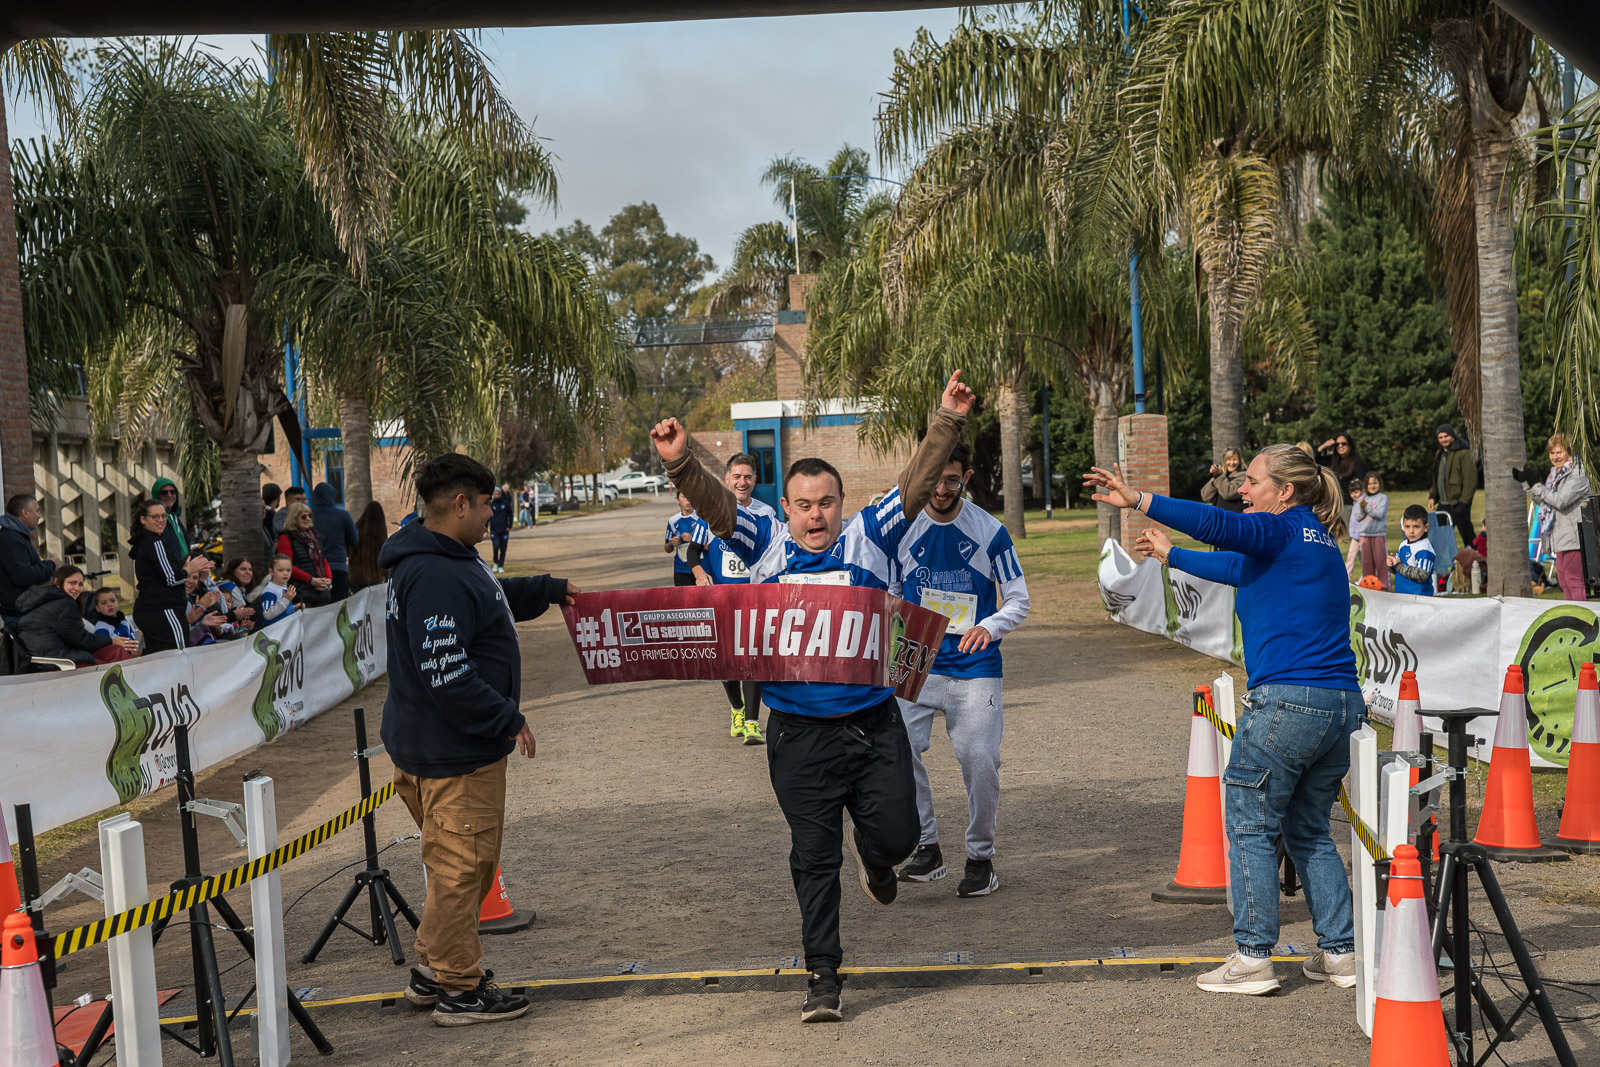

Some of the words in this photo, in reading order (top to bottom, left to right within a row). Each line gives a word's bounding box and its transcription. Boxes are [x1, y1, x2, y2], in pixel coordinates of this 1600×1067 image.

[424, 615, 437, 631] El
[439, 614, 455, 630] club
[643, 613, 665, 621] GRUPO
[666, 612, 710, 620] ASEGURADOR
[576, 608, 618, 648] #1
[645, 625, 660, 639] la
[660, 622, 712, 641] segunda
[734, 608, 880, 661] LLEGADA
[422, 635, 432, 649] de
[582, 648, 621, 669] VOS
[625, 650, 639, 662] LO
[641, 648, 679, 661] PRIMERO
[421, 658, 437, 671] más
[431, 673, 442, 688] del
